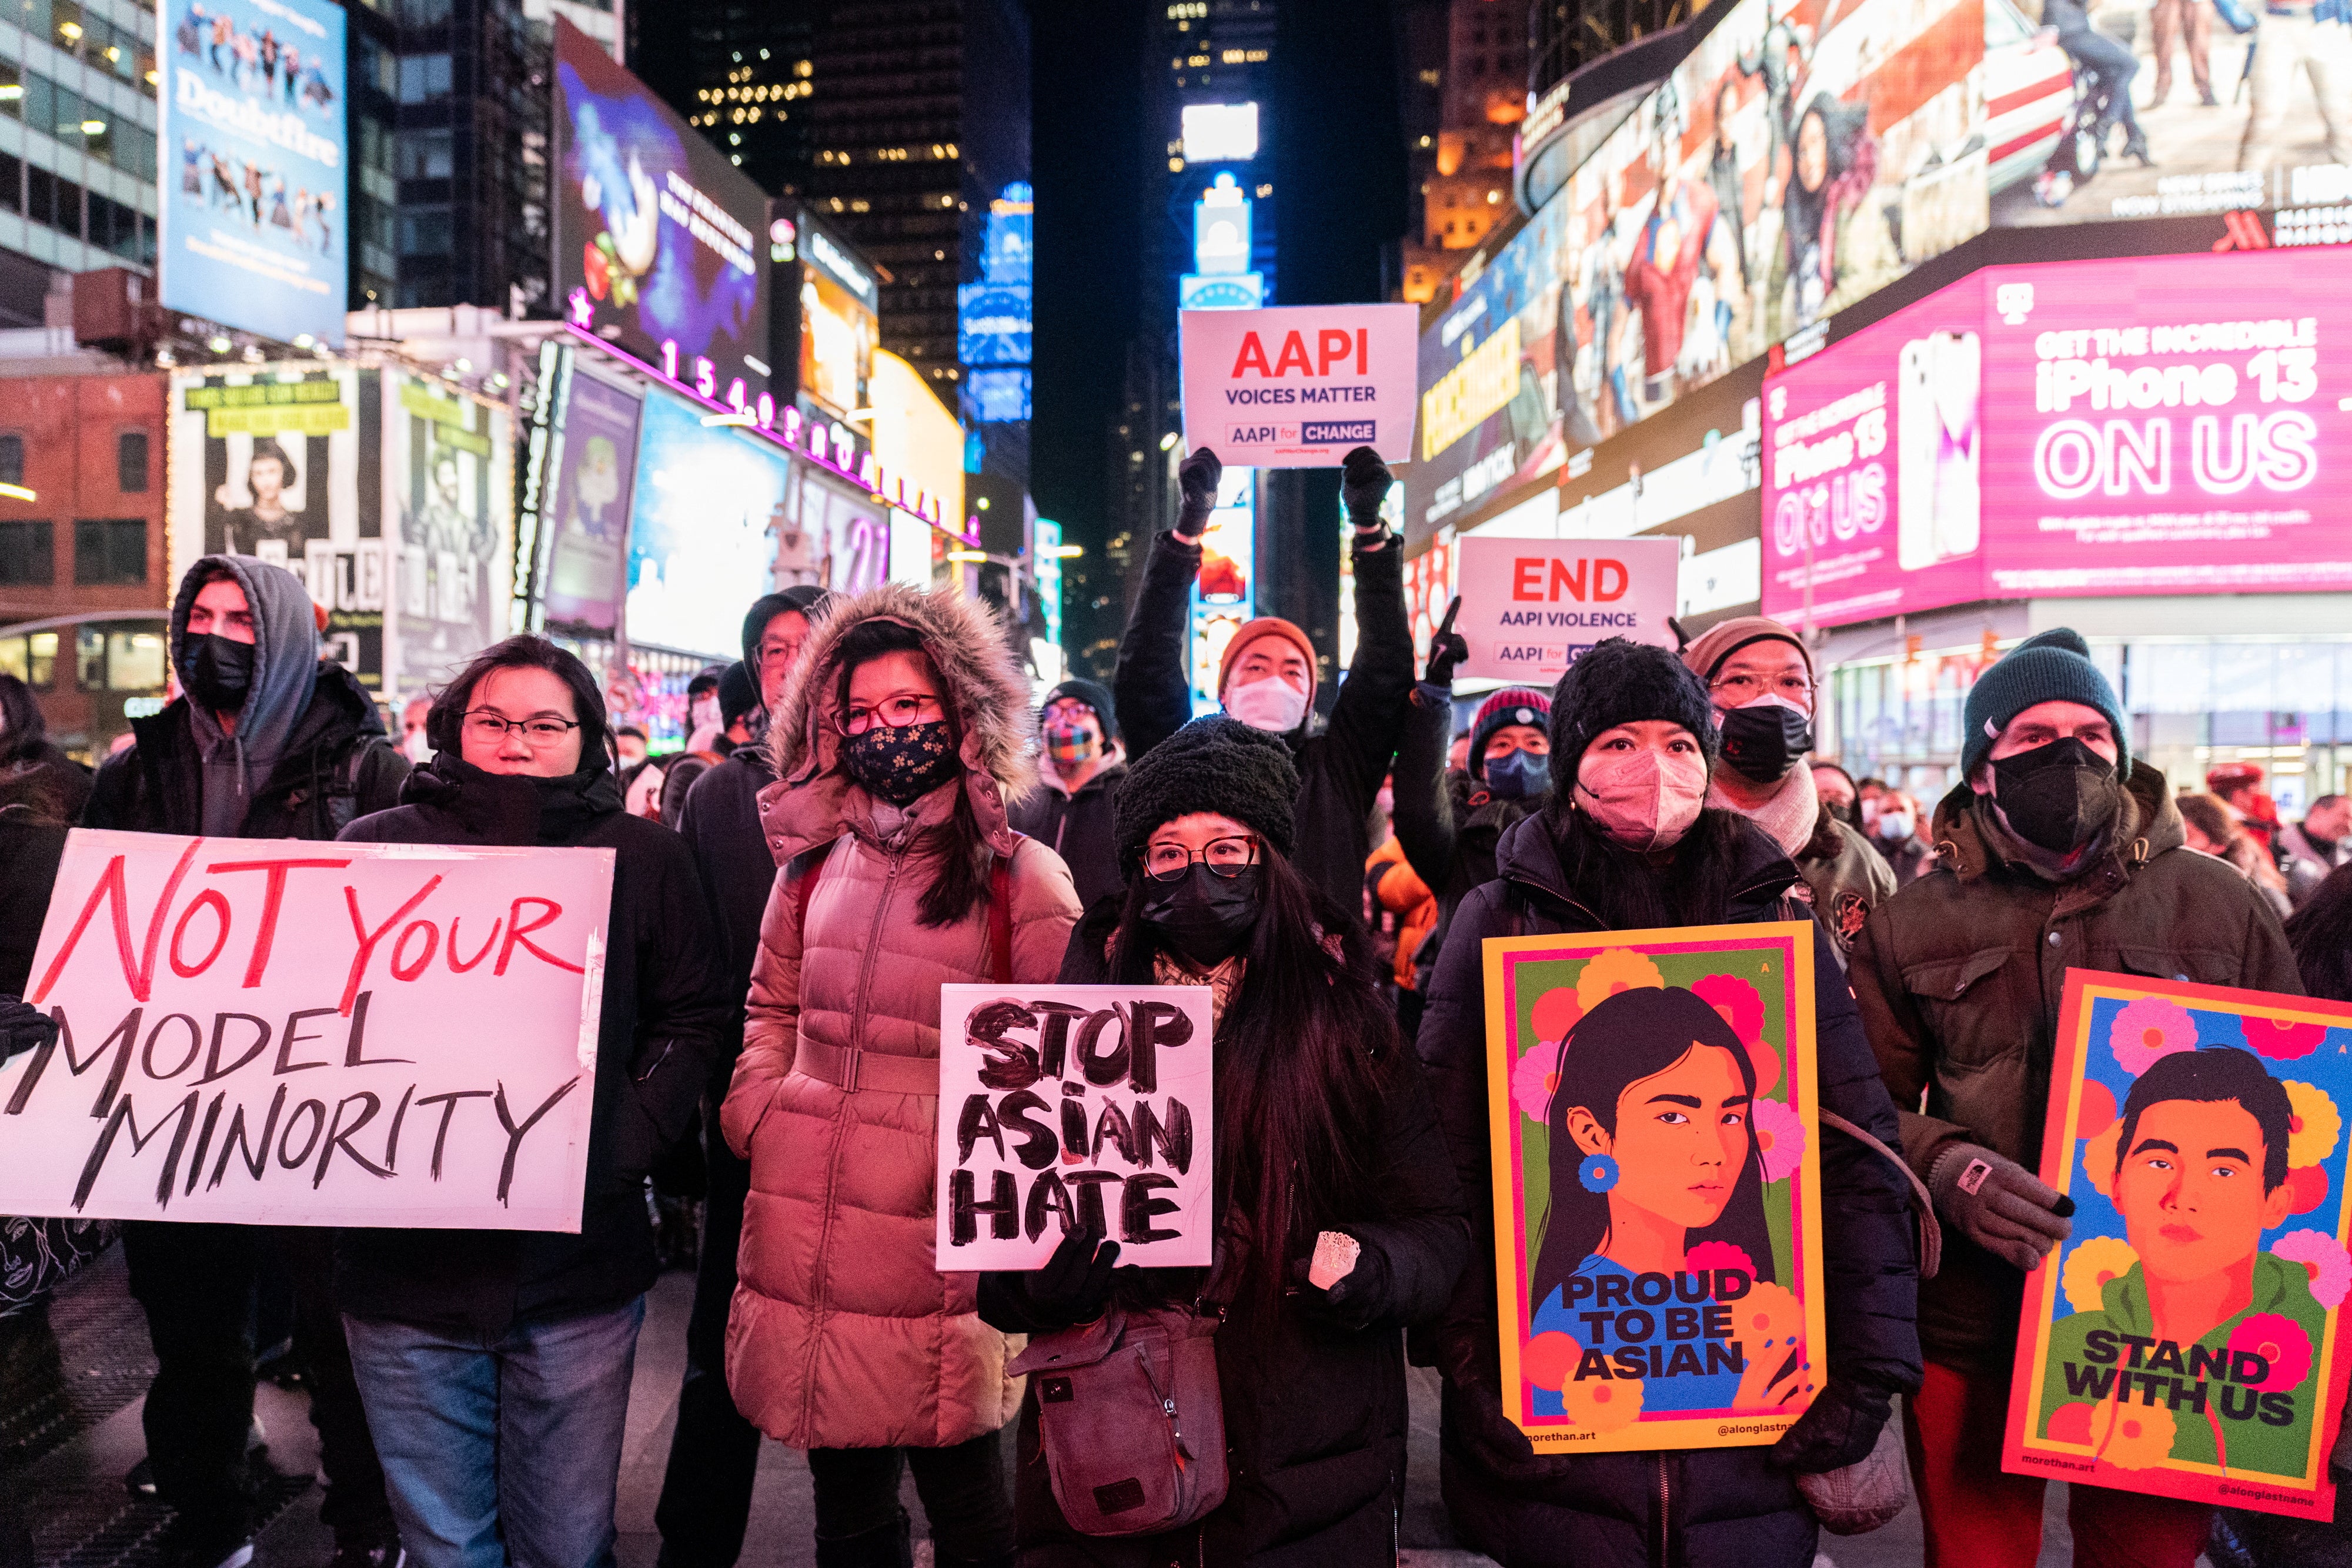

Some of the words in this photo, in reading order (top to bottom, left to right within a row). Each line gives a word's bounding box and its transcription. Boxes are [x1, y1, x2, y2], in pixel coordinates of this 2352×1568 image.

[176, 67, 339, 167] Doubtfire
[1231, 329, 1367, 378] AAPI
[2036, 330, 2091, 359] GET
[2091, 327, 2148, 357] THE
[2152, 317, 2317, 354] INCREDIBLE
[1225, 389, 1295, 406] VOICES
[1301, 386, 1375, 403] MATTER
[2036, 357, 2238, 412] iPhone
[2246, 347, 2317, 403] 13
[1232, 427, 1276, 443] AAPI
[1280, 428, 1297, 440] for
[1305, 424, 1373, 440] CHANGE
[2034, 417, 2170, 499] ON
[2192, 411, 2317, 493] US
[1832, 463, 1887, 540] US
[1513, 557, 1628, 602] END
[1499, 611, 1542, 626] AAPI
[1547, 613, 1636, 627] VIOLENCE
[1499, 647, 1542, 661] AAPI
[1546, 648, 1562, 658] for
[30, 837, 351, 1002] NOT
[338, 870, 585, 1016] YOUR
[4, 991, 416, 1119] MODEL
[964, 997, 1193, 1094] STOP
[71, 1074, 582, 1212] MINORITY
[949, 1168, 1182, 1246] HATE
[1562, 1269, 1751, 1310] PROUD
[1579, 1311, 1655, 1344] TO
[1666, 1305, 1735, 1341] BE
[1573, 1342, 1743, 1382] ASIAN
[2083, 1330, 2270, 1386] STAND
[2063, 1362, 2209, 1416] WITH
[2220, 1386, 2294, 1427] US
[2022, 1454, 2095, 1473] morethan.art
[2218, 1483, 2314, 1506] @alonglastname
